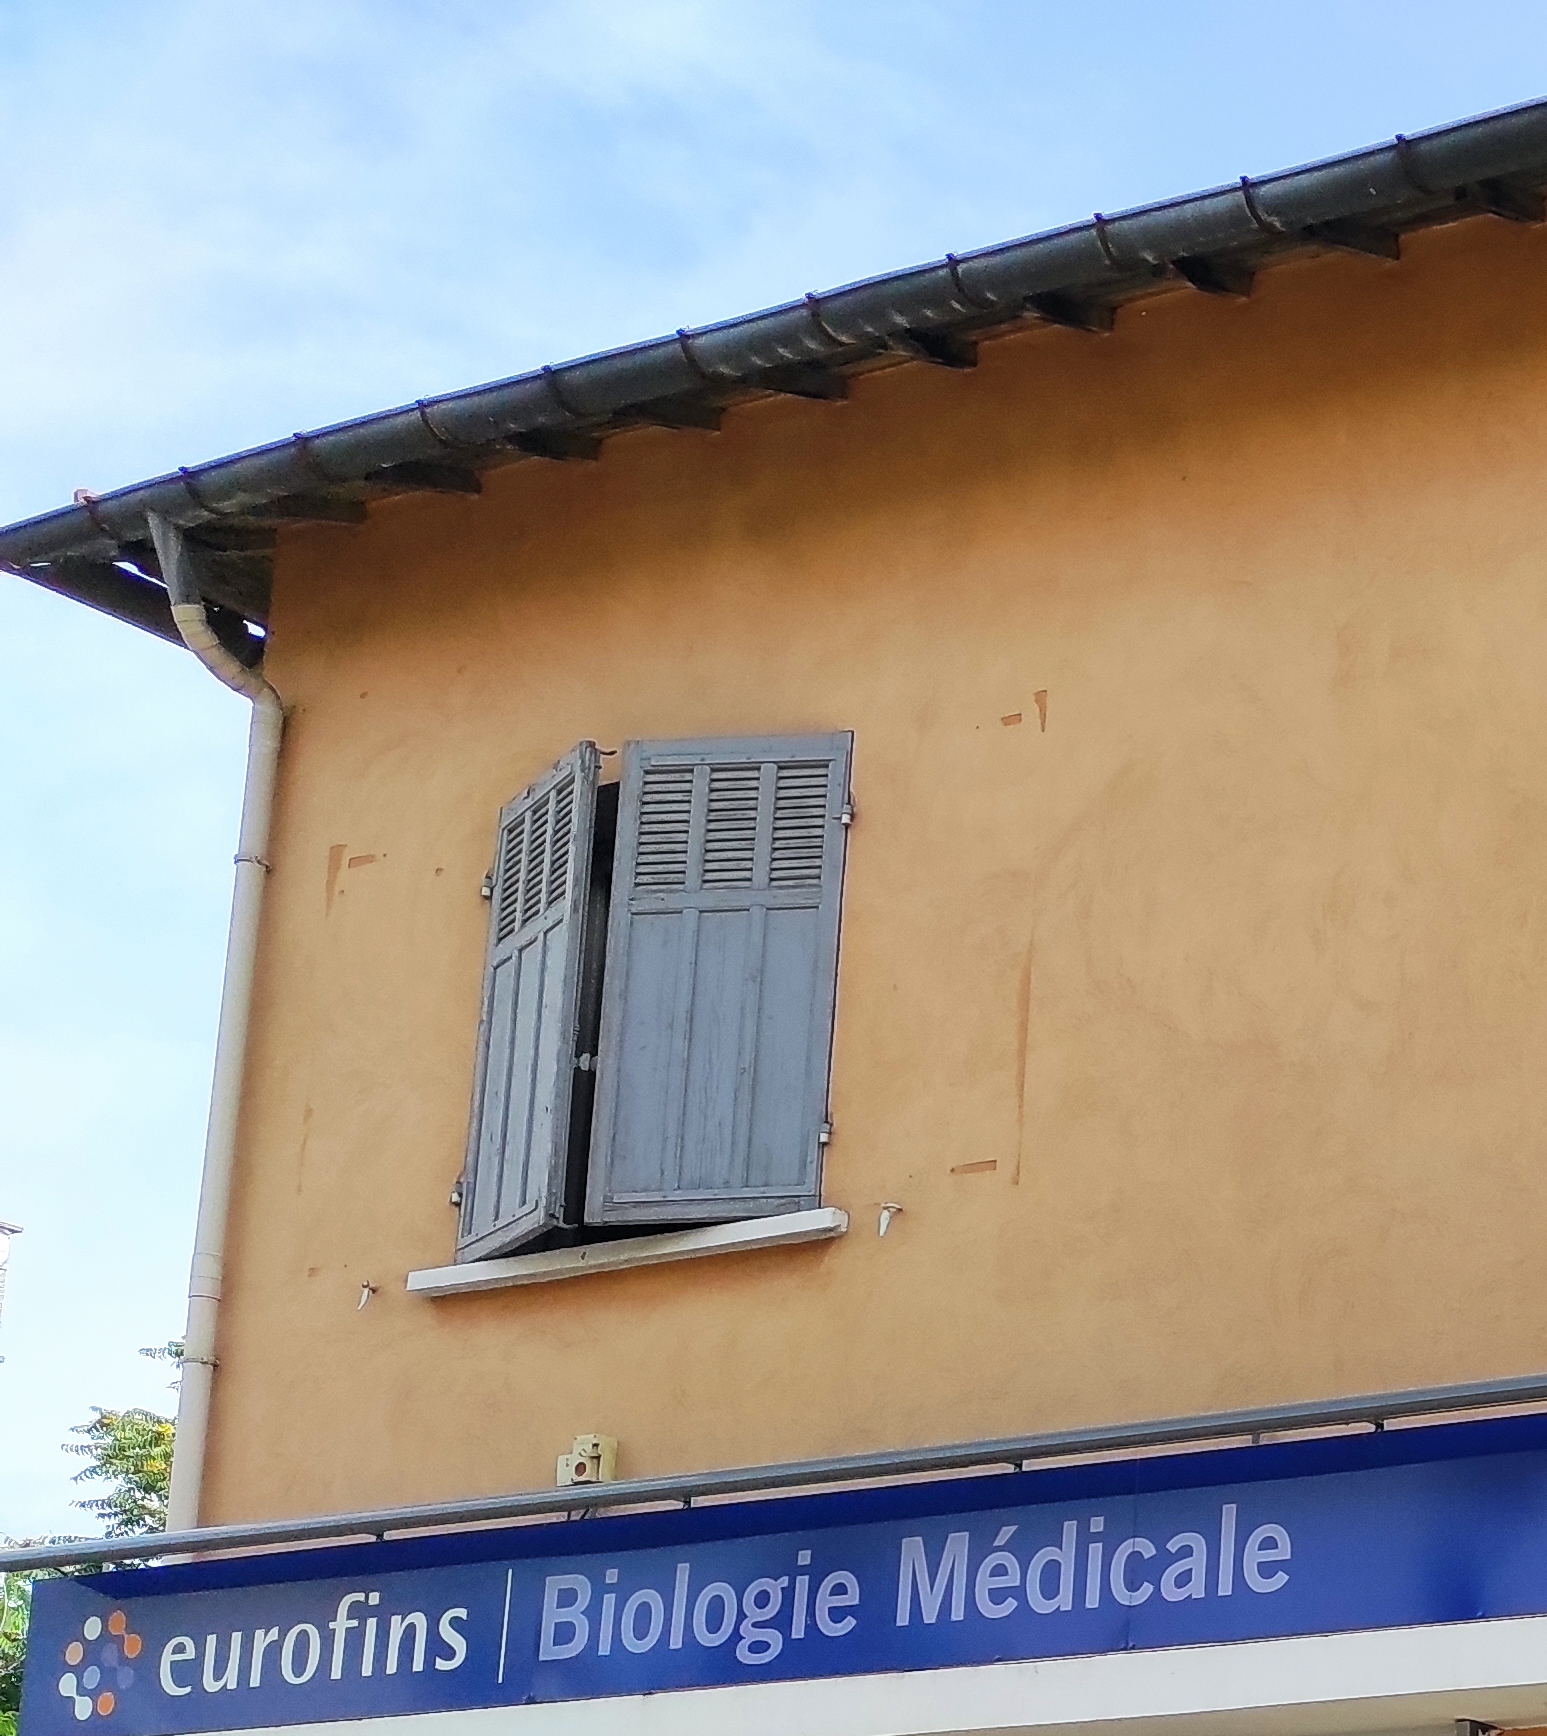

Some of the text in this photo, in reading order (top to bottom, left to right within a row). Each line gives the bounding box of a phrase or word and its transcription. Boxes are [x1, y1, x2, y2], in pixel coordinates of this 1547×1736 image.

[159, 1503, 1292, 1696] eurofins Biologie Médicale
